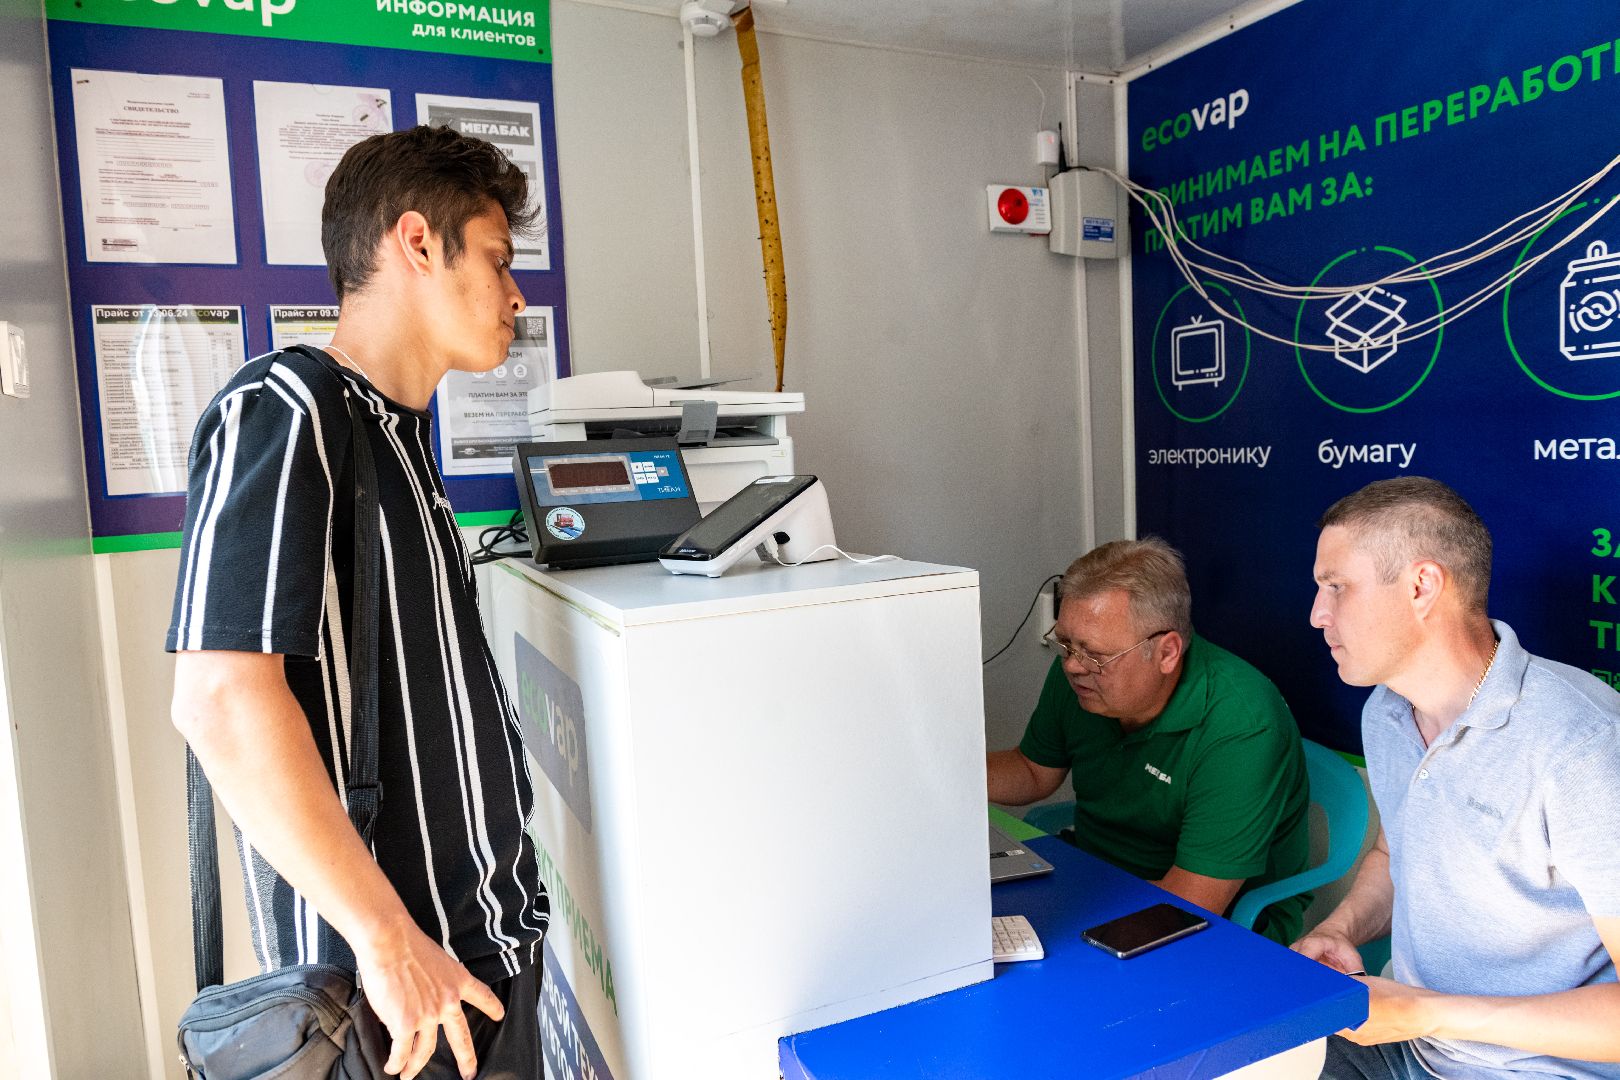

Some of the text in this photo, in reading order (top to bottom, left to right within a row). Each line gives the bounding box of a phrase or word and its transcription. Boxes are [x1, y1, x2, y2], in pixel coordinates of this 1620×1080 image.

[376, 0, 535, 27] ИНФОРМАЦИЯ
[412, 23, 536, 47] для клиентов
[123, 105, 180, 114] СВИДЕТЕЛЬСТВО
[1319, 124, 1367, 163] НА
[1375, 38, 1620, 147] ПЕРЕРАБОТ
[460, 121, 531, 138] МЕГАБАК
[1142, 88, 1250, 153] ecovap
[1250, 187, 1313, 226] ВАМ
[1321, 171, 1373, 207] ЗА:
[96, 308, 130, 320] Прайс
[274, 309, 305, 318] Прайс
[320, 309, 339, 317] 09.0
[1148, 443, 1272, 469] электронику
[1317, 438, 1417, 469] бумагу
[1534, 437, 1620, 460] мета
[1589, 619, 1620, 651] Т
[521, 671, 579, 787] ecovap
[556, 868, 618, 1017] ПРИЕМА
[571, 1020, 599, 1080] ТЕ
